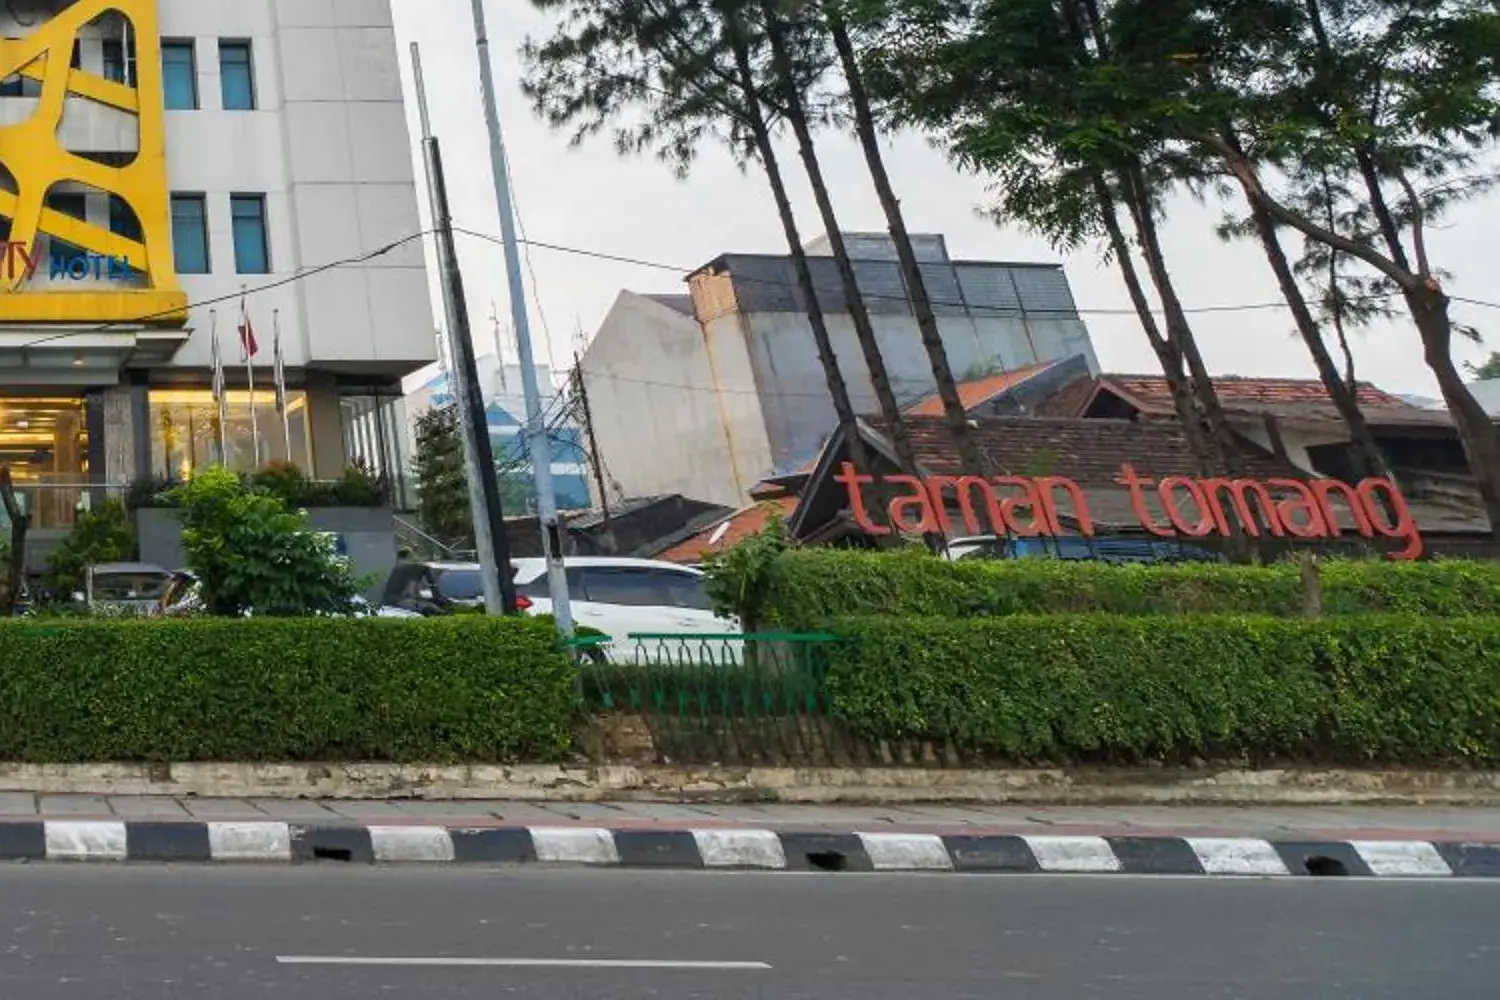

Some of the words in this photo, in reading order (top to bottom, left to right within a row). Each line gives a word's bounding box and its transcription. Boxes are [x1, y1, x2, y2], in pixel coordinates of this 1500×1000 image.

[49, 254, 136, 281] HOTEL
[834, 461, 1095, 535] taman
[1114, 462, 1425, 562] tomang
